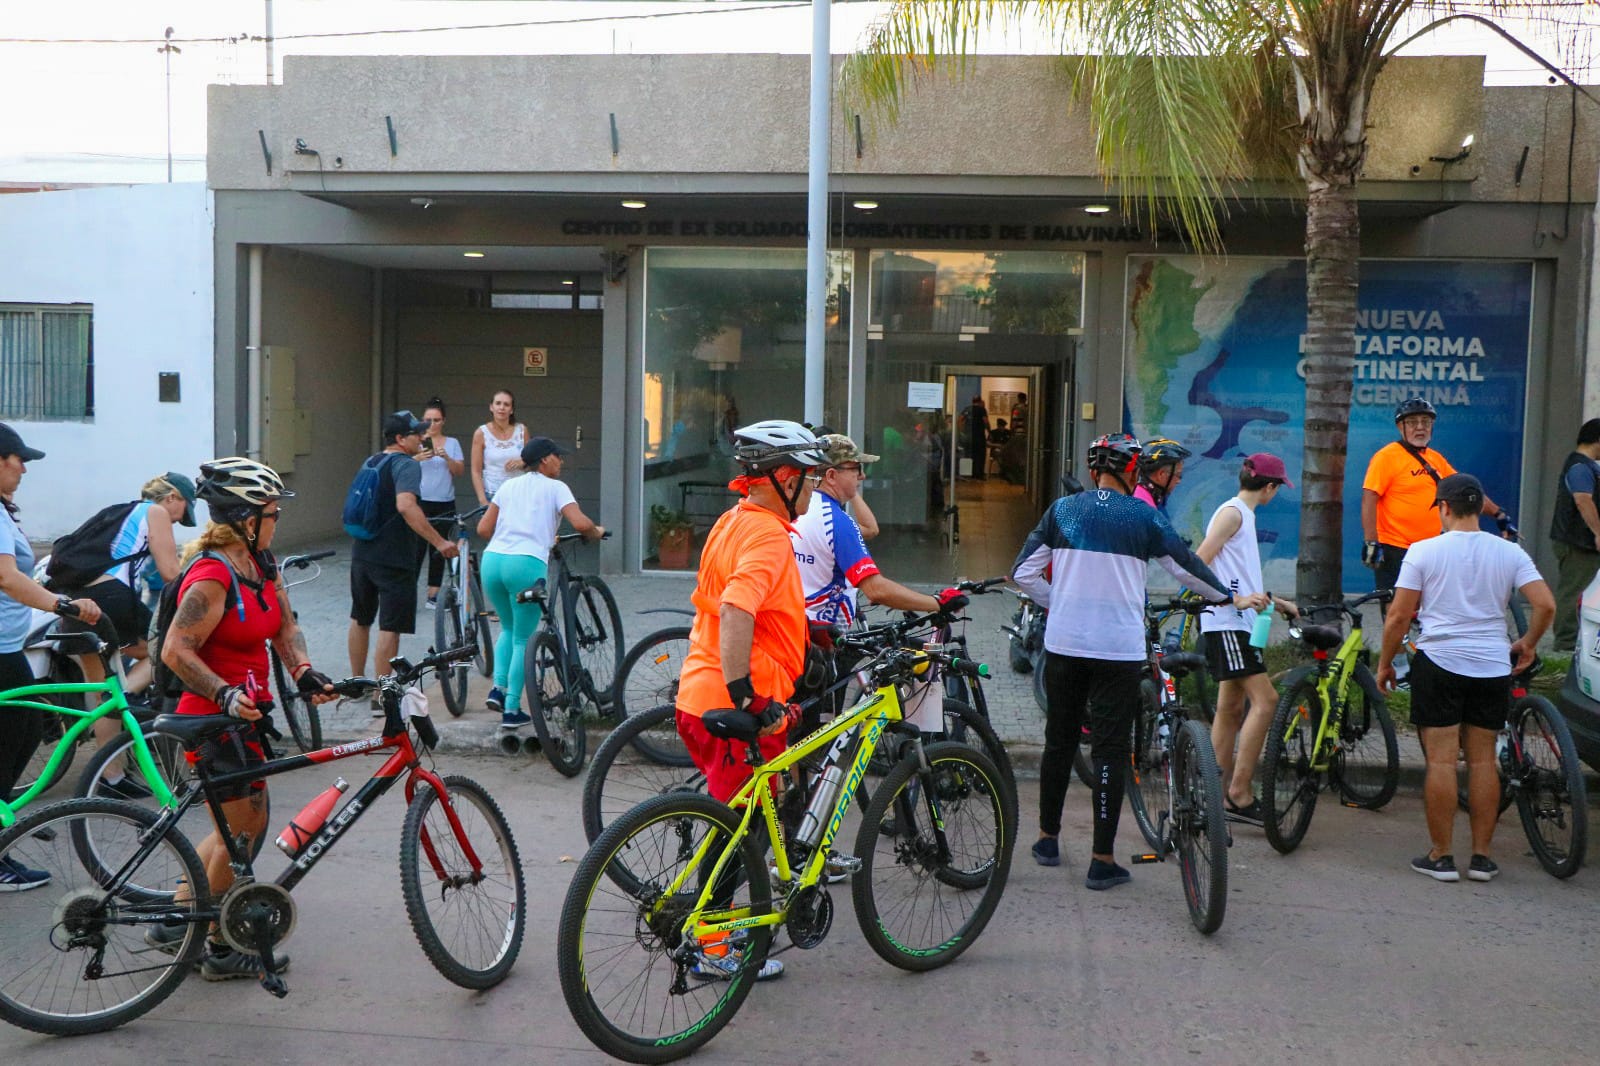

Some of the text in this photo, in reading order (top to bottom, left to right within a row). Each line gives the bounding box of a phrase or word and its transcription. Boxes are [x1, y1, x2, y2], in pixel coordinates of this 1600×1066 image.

[562, 221, 641, 236] CENTRO
[647, 221, 673, 236] DE
[681, 221, 707, 237] EX
[714, 221, 807, 237] SOLDADO
[831, 223, 991, 240] COMBATIENTES
[999, 225, 1026, 240] DE
[1032, 226, 1142, 242] MALVINAS
[1354, 309, 1445, 331] NUEVA
[1299, 334, 1486, 357] TAFORMA
[1296, 359, 1485, 382] CTINENTAL
[820, 748, 870, 856] NORDIC
[296, 799, 363, 868] ROLLER
[718, 917, 761, 931] NORDIC
[654, 995, 727, 1047] NORDIC
